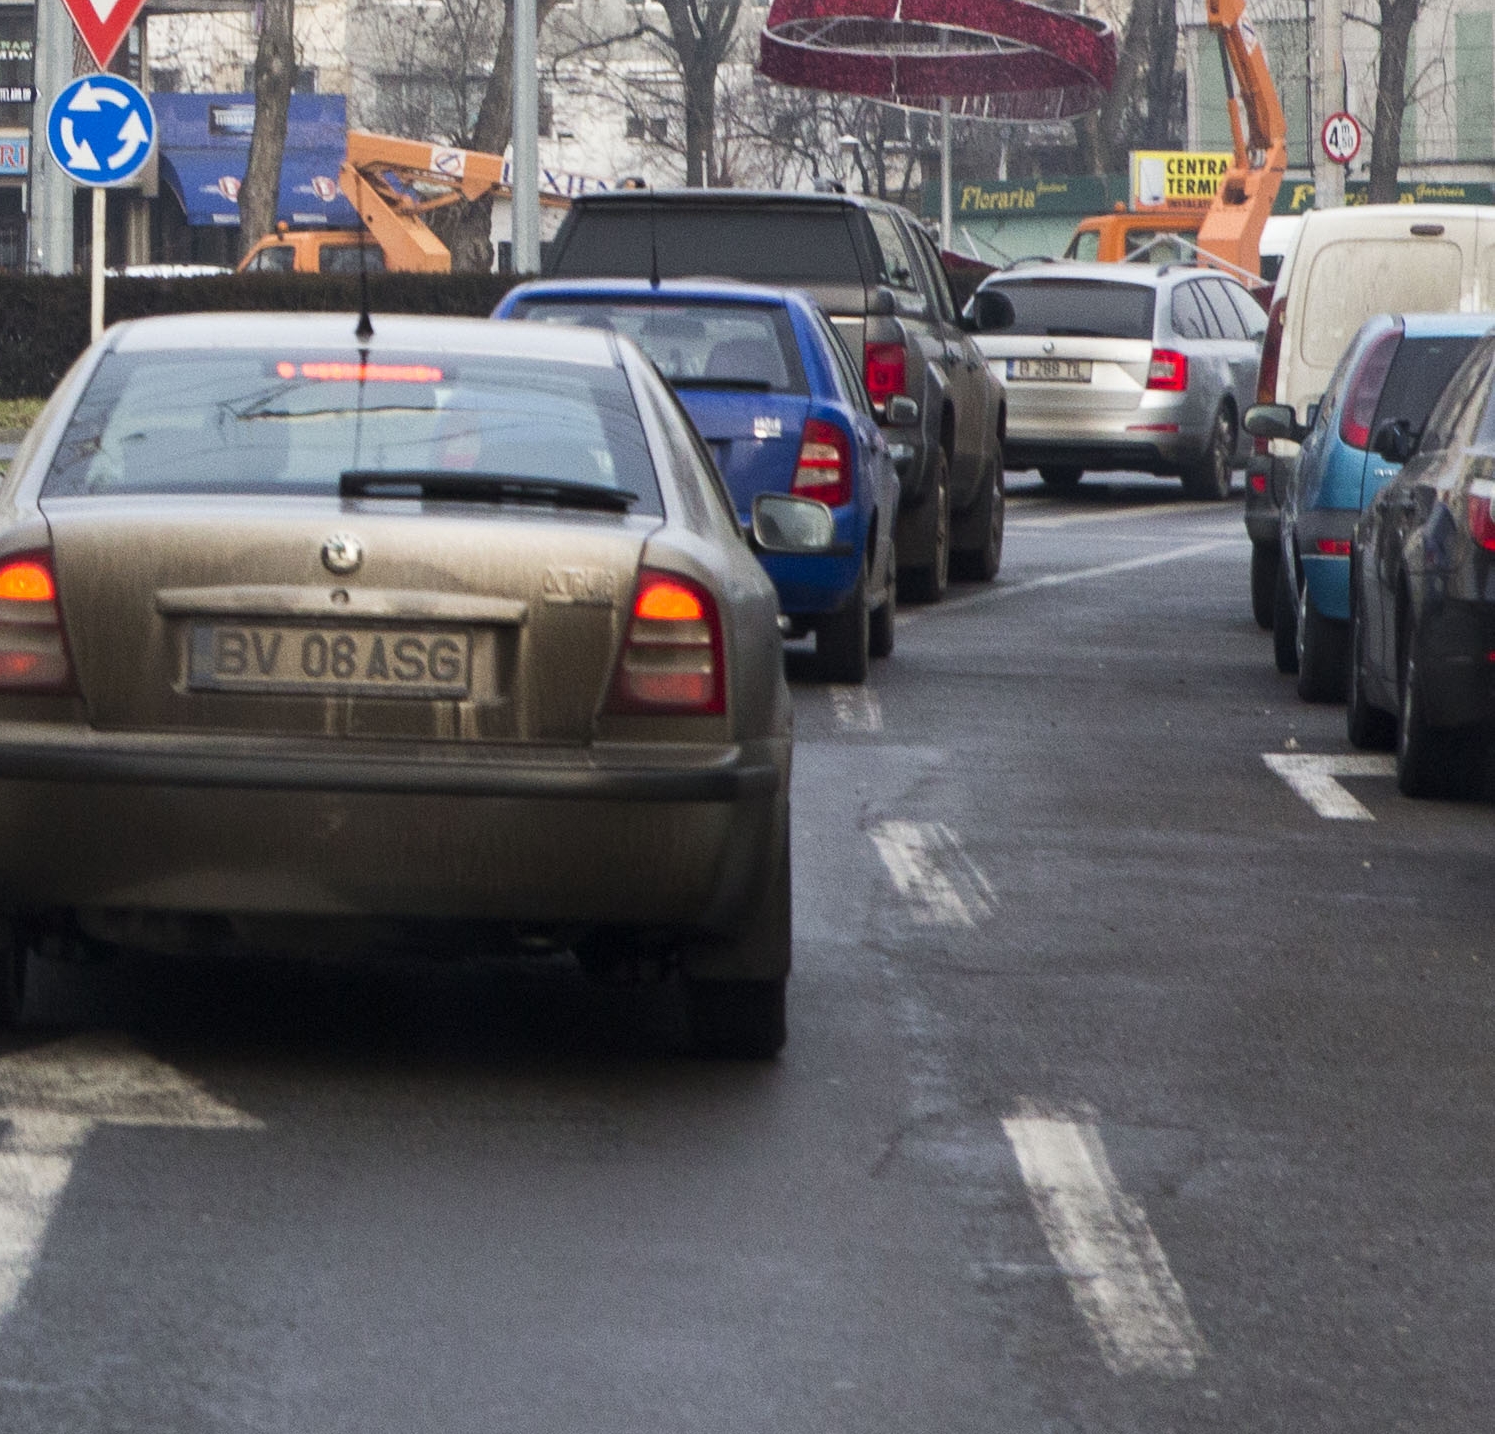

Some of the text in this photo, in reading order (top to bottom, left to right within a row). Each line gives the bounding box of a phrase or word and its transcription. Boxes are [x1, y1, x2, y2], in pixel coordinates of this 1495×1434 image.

[1167, 158, 1228, 175] CENTRA
[1167, 178, 1217, 195] TERMI
[215, 631, 461, 681] BV 08 ASG
